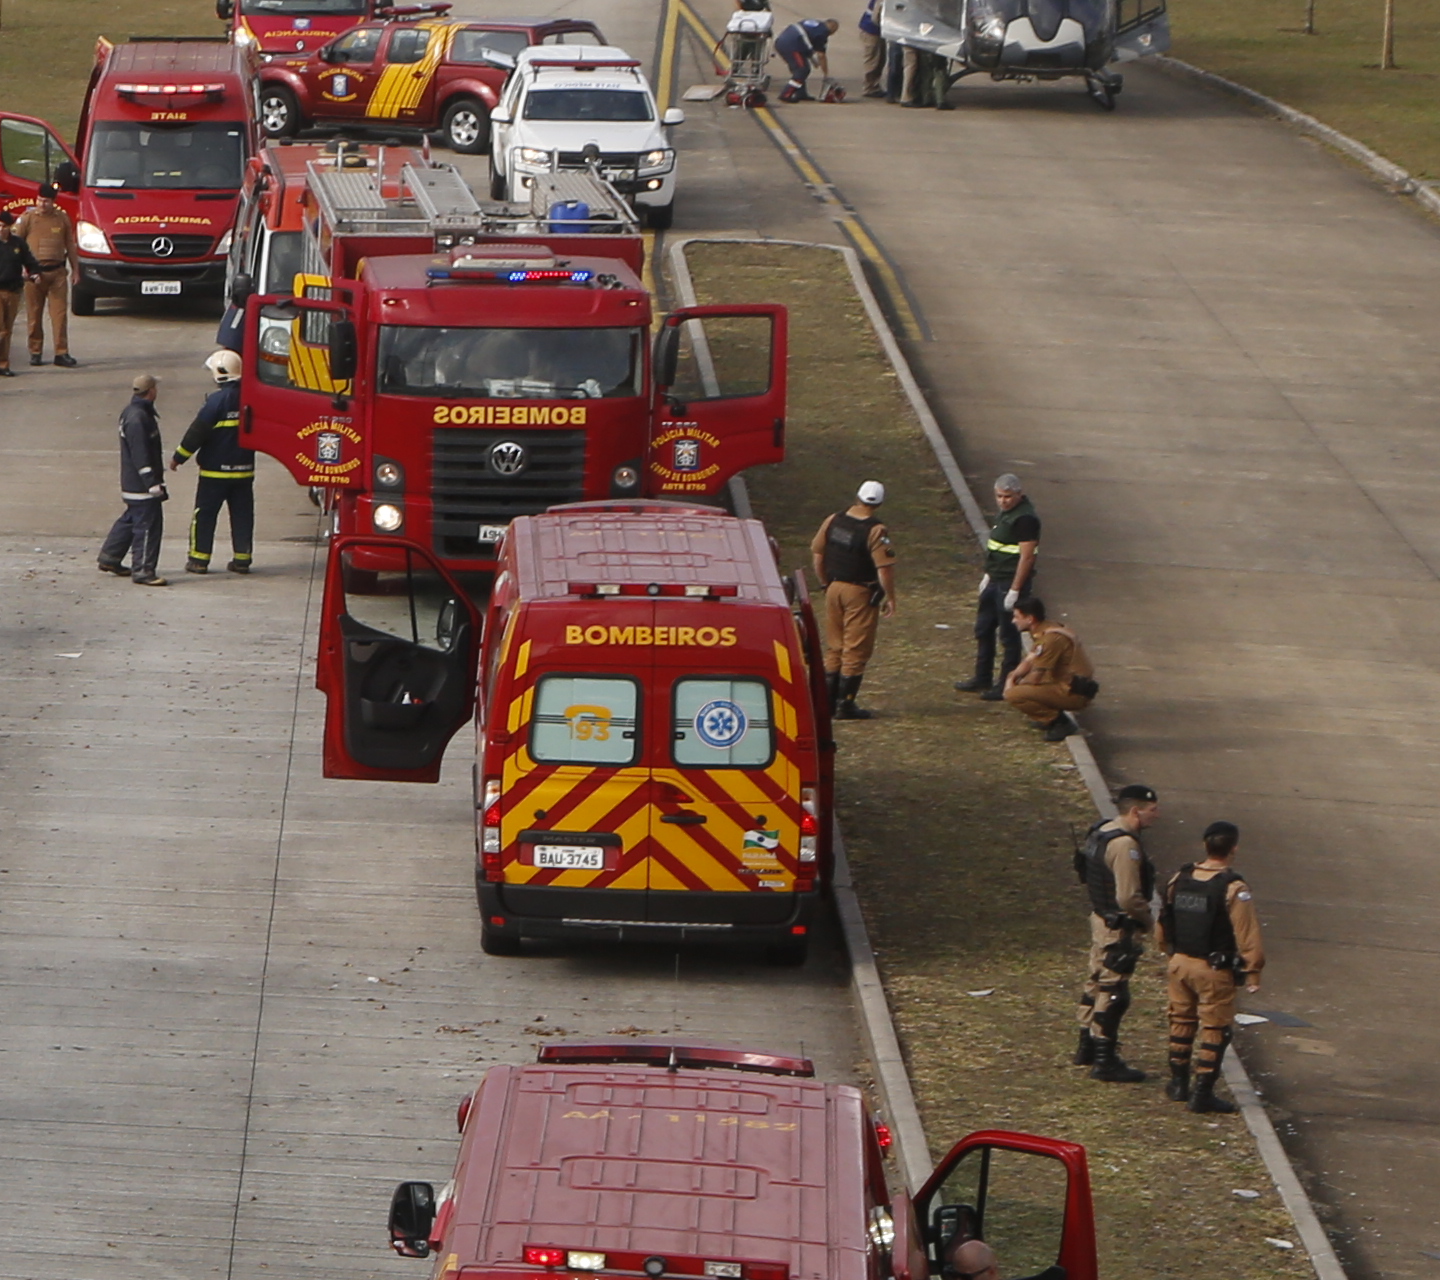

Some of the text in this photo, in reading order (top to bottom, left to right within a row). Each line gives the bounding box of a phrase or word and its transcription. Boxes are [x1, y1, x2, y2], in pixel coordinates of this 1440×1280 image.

[297, 421, 362, 444] POLÍCIA MILITAR
[652, 428, 721, 448] POLÍCIA MILITAR
[564, 625, 738, 647] BOMBEIROS
[568, 720, 610, 741] 193
[539, 852, 598, 867] BAU-3745
